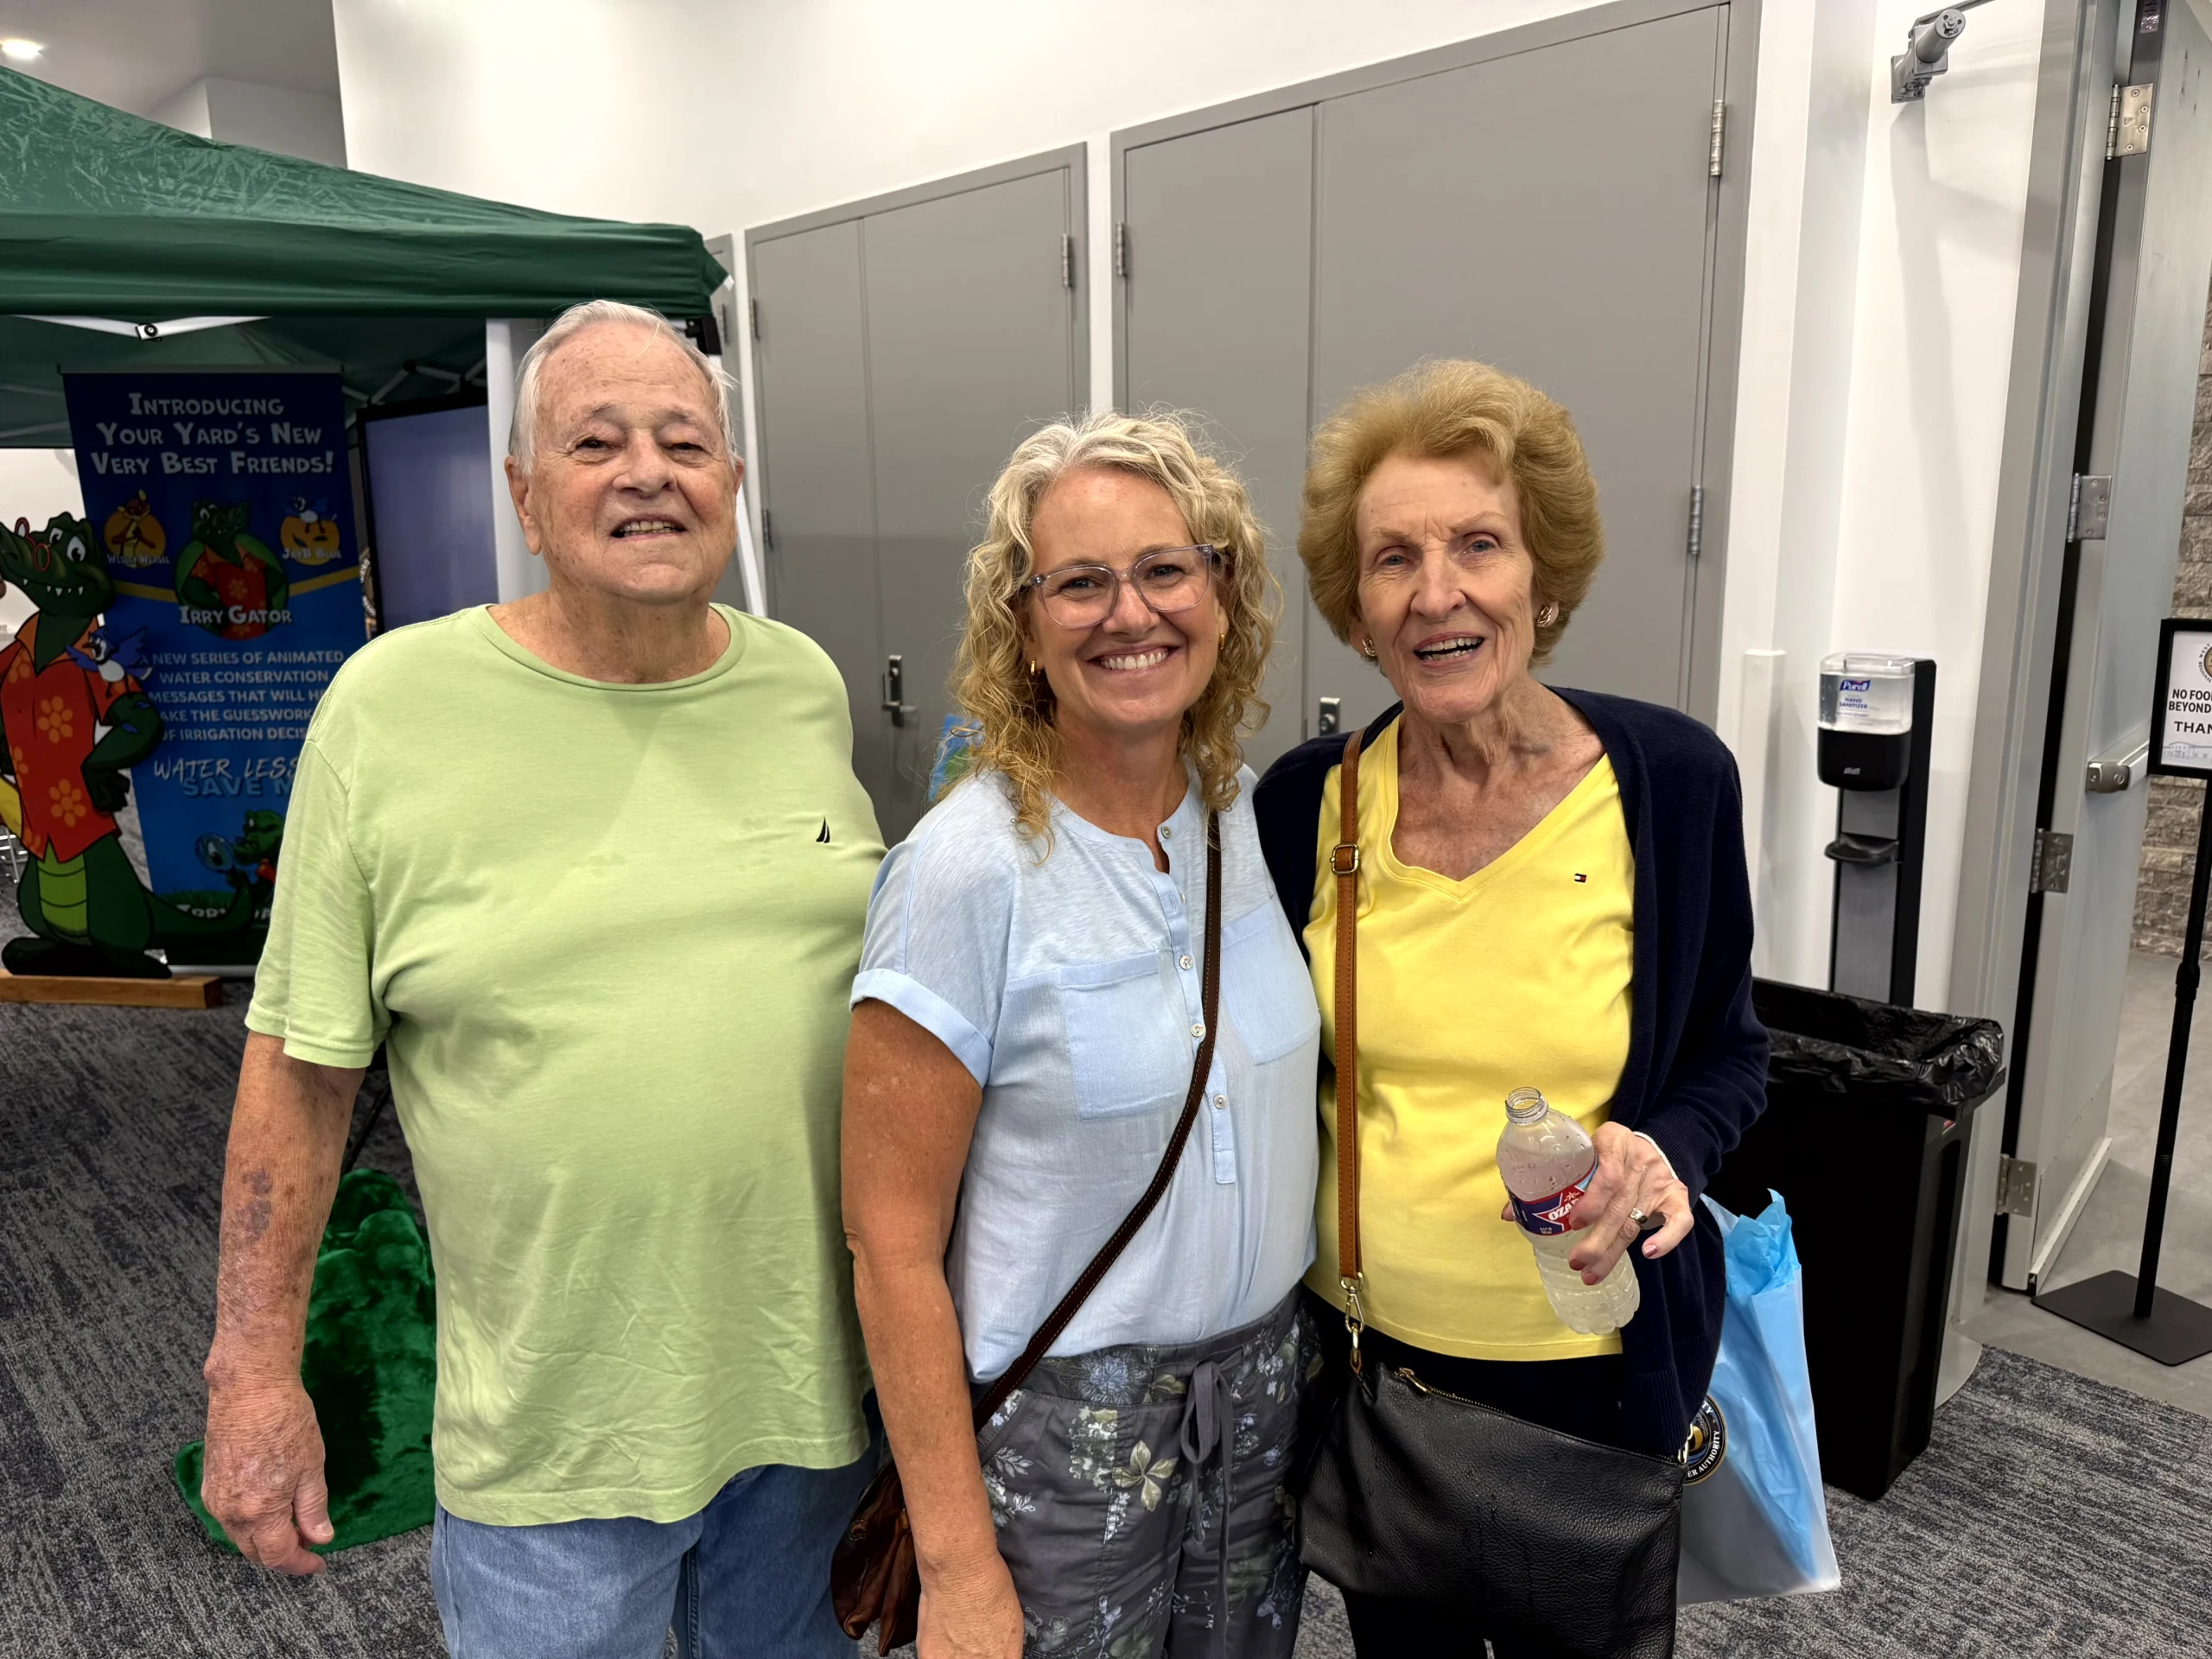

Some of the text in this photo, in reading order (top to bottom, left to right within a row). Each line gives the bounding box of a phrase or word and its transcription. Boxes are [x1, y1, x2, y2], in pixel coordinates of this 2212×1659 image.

[129, 392, 284, 416] INTRODUCING
[96, 422, 322, 446] YOUR YARD'S NEW
[91, 450, 334, 474] VERY BEST FRIENDS!
[180, 605, 292, 625] IRRY GATOR
[152, 652, 187, 665] NEW
[191, 652, 239, 665] SERIES
[242, 651, 264, 664] OF
[267, 650, 345, 664] ANIMATED
[159, 670, 329, 684] WATER CONSERVATION
[147, 690, 226, 704] MESSAGES
[228, 690, 267, 703] THAT
[270, 689, 306, 702] WILL
[2172, 689, 2212, 701] NO FOO
[159, 708, 312, 722] AKE THE GUESSWORK
[2169, 701, 2211, 714] BEYOND
[180, 728, 264, 741] IRRIGATION
[267, 727, 308, 741] DECIS
[2174, 721, 2212, 734] THAN
[154, 755, 232, 783] WATER
[183, 778, 263, 797] SAVE
[1698, 1431, 1720, 1473] AUTHORITY
